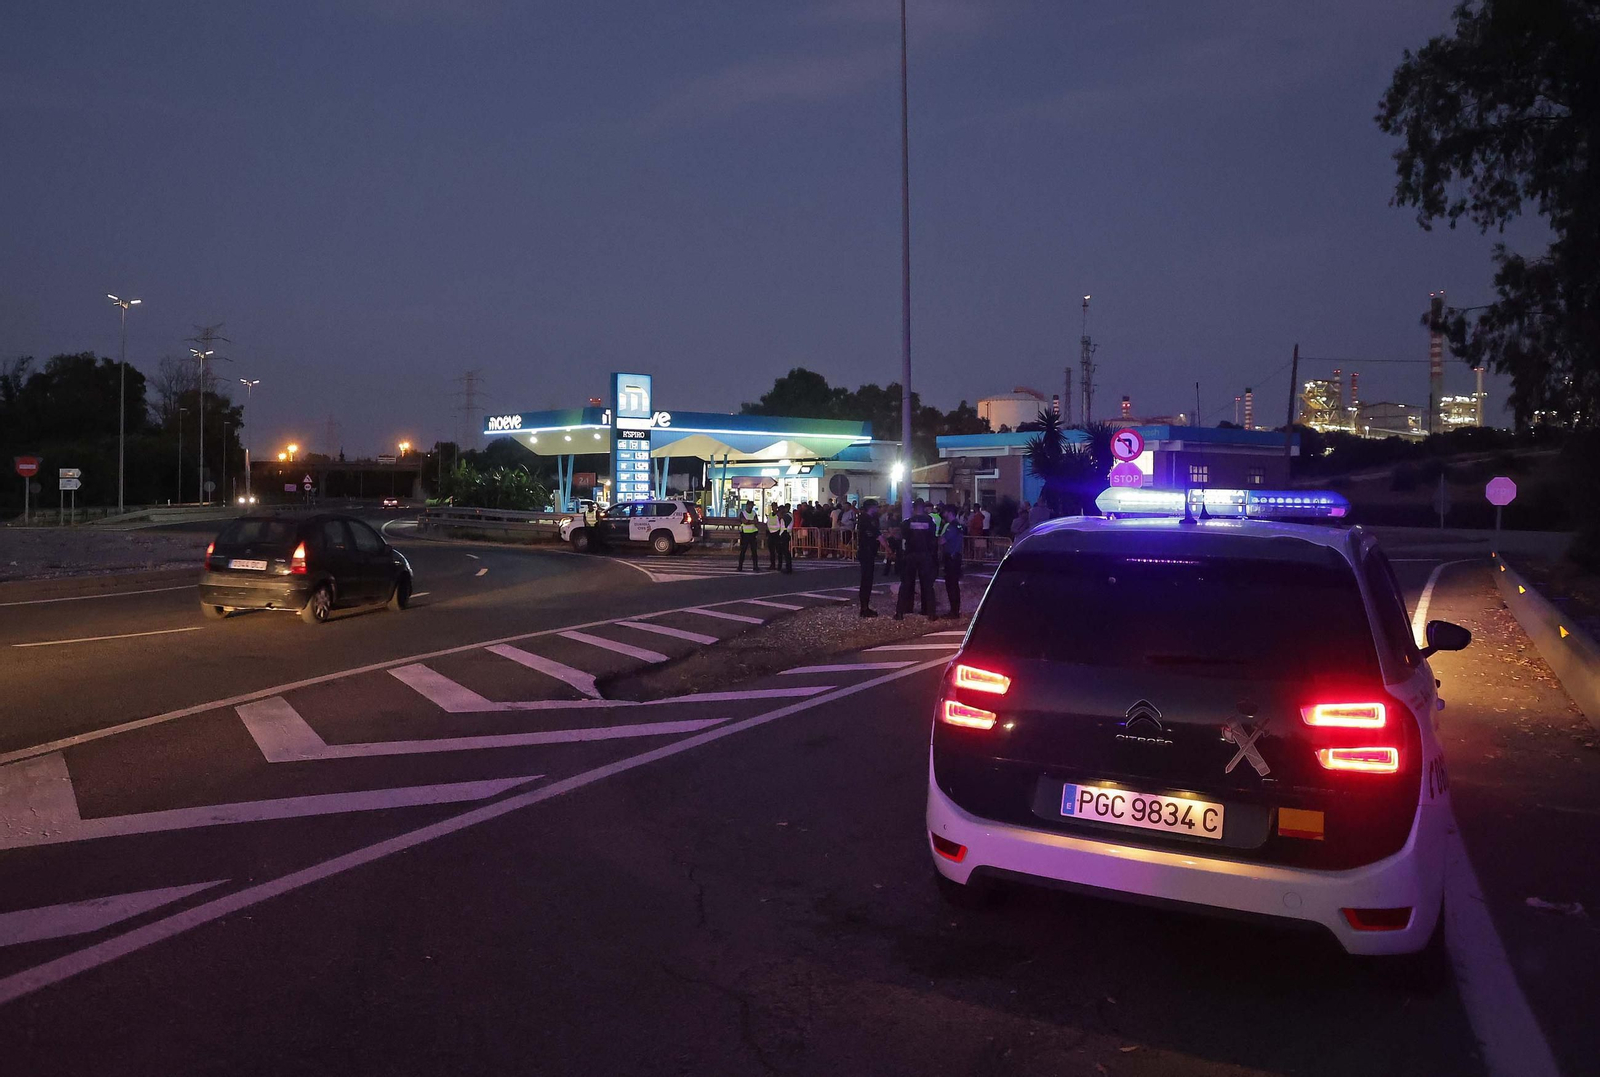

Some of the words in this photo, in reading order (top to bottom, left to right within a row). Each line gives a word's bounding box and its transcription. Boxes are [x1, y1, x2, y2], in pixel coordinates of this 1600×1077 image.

[488, 414, 522, 431] moeve
[1113, 474, 1140, 483] STOP
[1066, 802, 1072, 810] E
[1078, 790, 1126, 819] PGC
[1131, 798, 1196, 830] 9834
[1203, 808, 1219, 833] C
